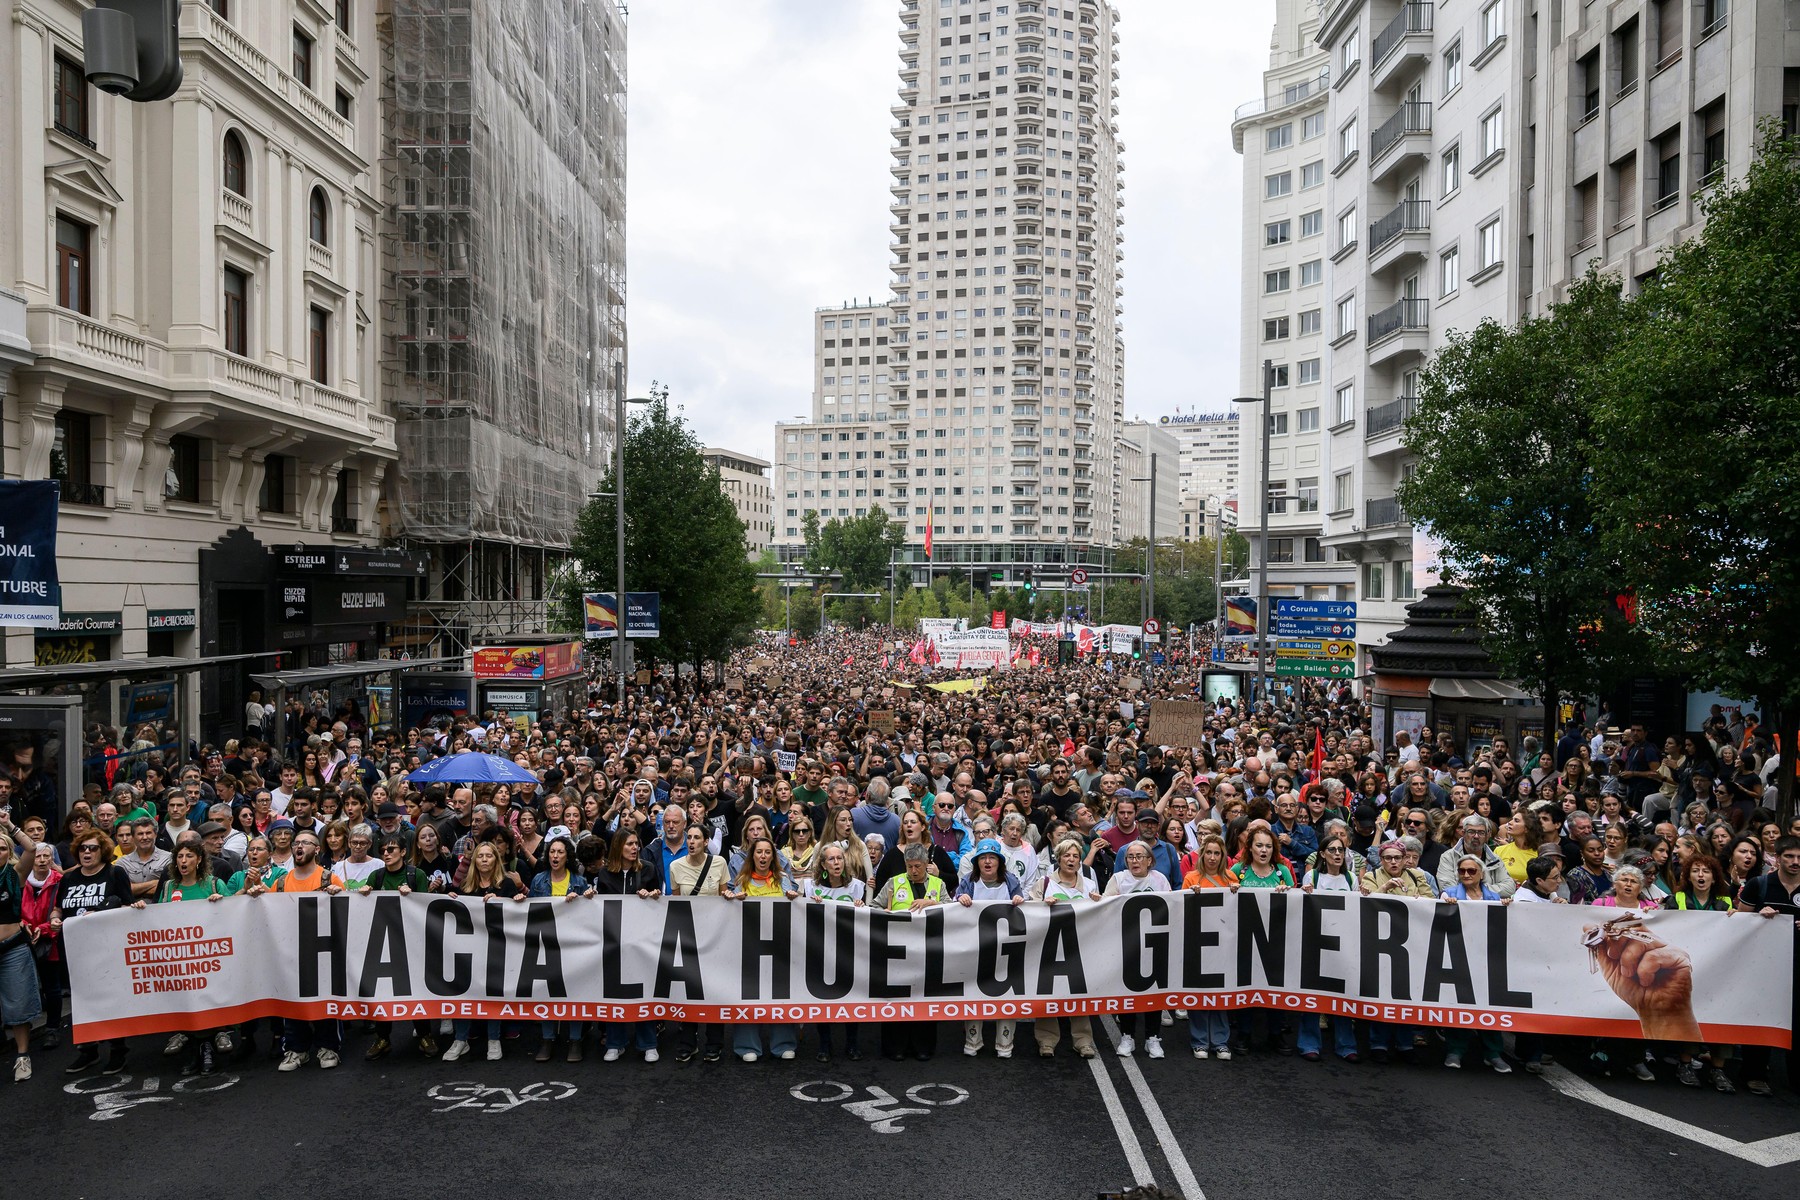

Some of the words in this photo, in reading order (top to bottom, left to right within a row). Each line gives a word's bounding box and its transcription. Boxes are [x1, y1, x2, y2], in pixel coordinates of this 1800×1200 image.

[1171, 414, 1196, 424] Hotel
[285, 555, 326, 564] ESTRELLA
[1, 580, 48, 597] TUBRE
[284, 587, 306, 596] CUZCO
[341, 592, 363, 608] CUZCO
[1290, 604, 1318, 613] Coruña
[47, 618, 83, 631] adería
[85, 617, 116, 630] Gourmet
[1279, 627, 1315, 635] direcciones
[1295, 641, 1321, 650] Badajoz
[1304, 664, 1327, 672] Bailén
[407, 696, 422, 705] Los
[423, 696, 466, 706] Miserables
[1155, 711, 1195, 724] BUITRES
[66, 881, 107, 899] 7291
[127, 925, 204, 945] SINDICATO
[129, 949, 148, 963] DE
[149, 940, 230, 962] INQUILINAS
[299, 896, 568, 1000] HACIA
[602, 900, 705, 1000] LA
[741, 901, 1088, 1000] HUELGA
[1121, 892, 1534, 1009] GENERAL
[131, 967, 141, 980] E
[142, 959, 222, 979] INQUILINOS
[133, 981, 152, 995] DE
[153, 976, 208, 993] MADRID
[326, 1002, 427, 1018] BAJADA
[440, 1002, 488, 1016] DEL
[499, 1003, 625, 1019] ALQUILER
[638, 1004, 686, 1018] 50%
[719, 1002, 915, 1020] EXPROPIACIÓN
[928, 1002, 1033, 1017] FONDOS
[1045, 998, 1135, 1015] BUITRE
[1165, 992, 1318, 1008] CONTRATOS
[1331, 999, 1514, 1028] INDEFINIDOS
